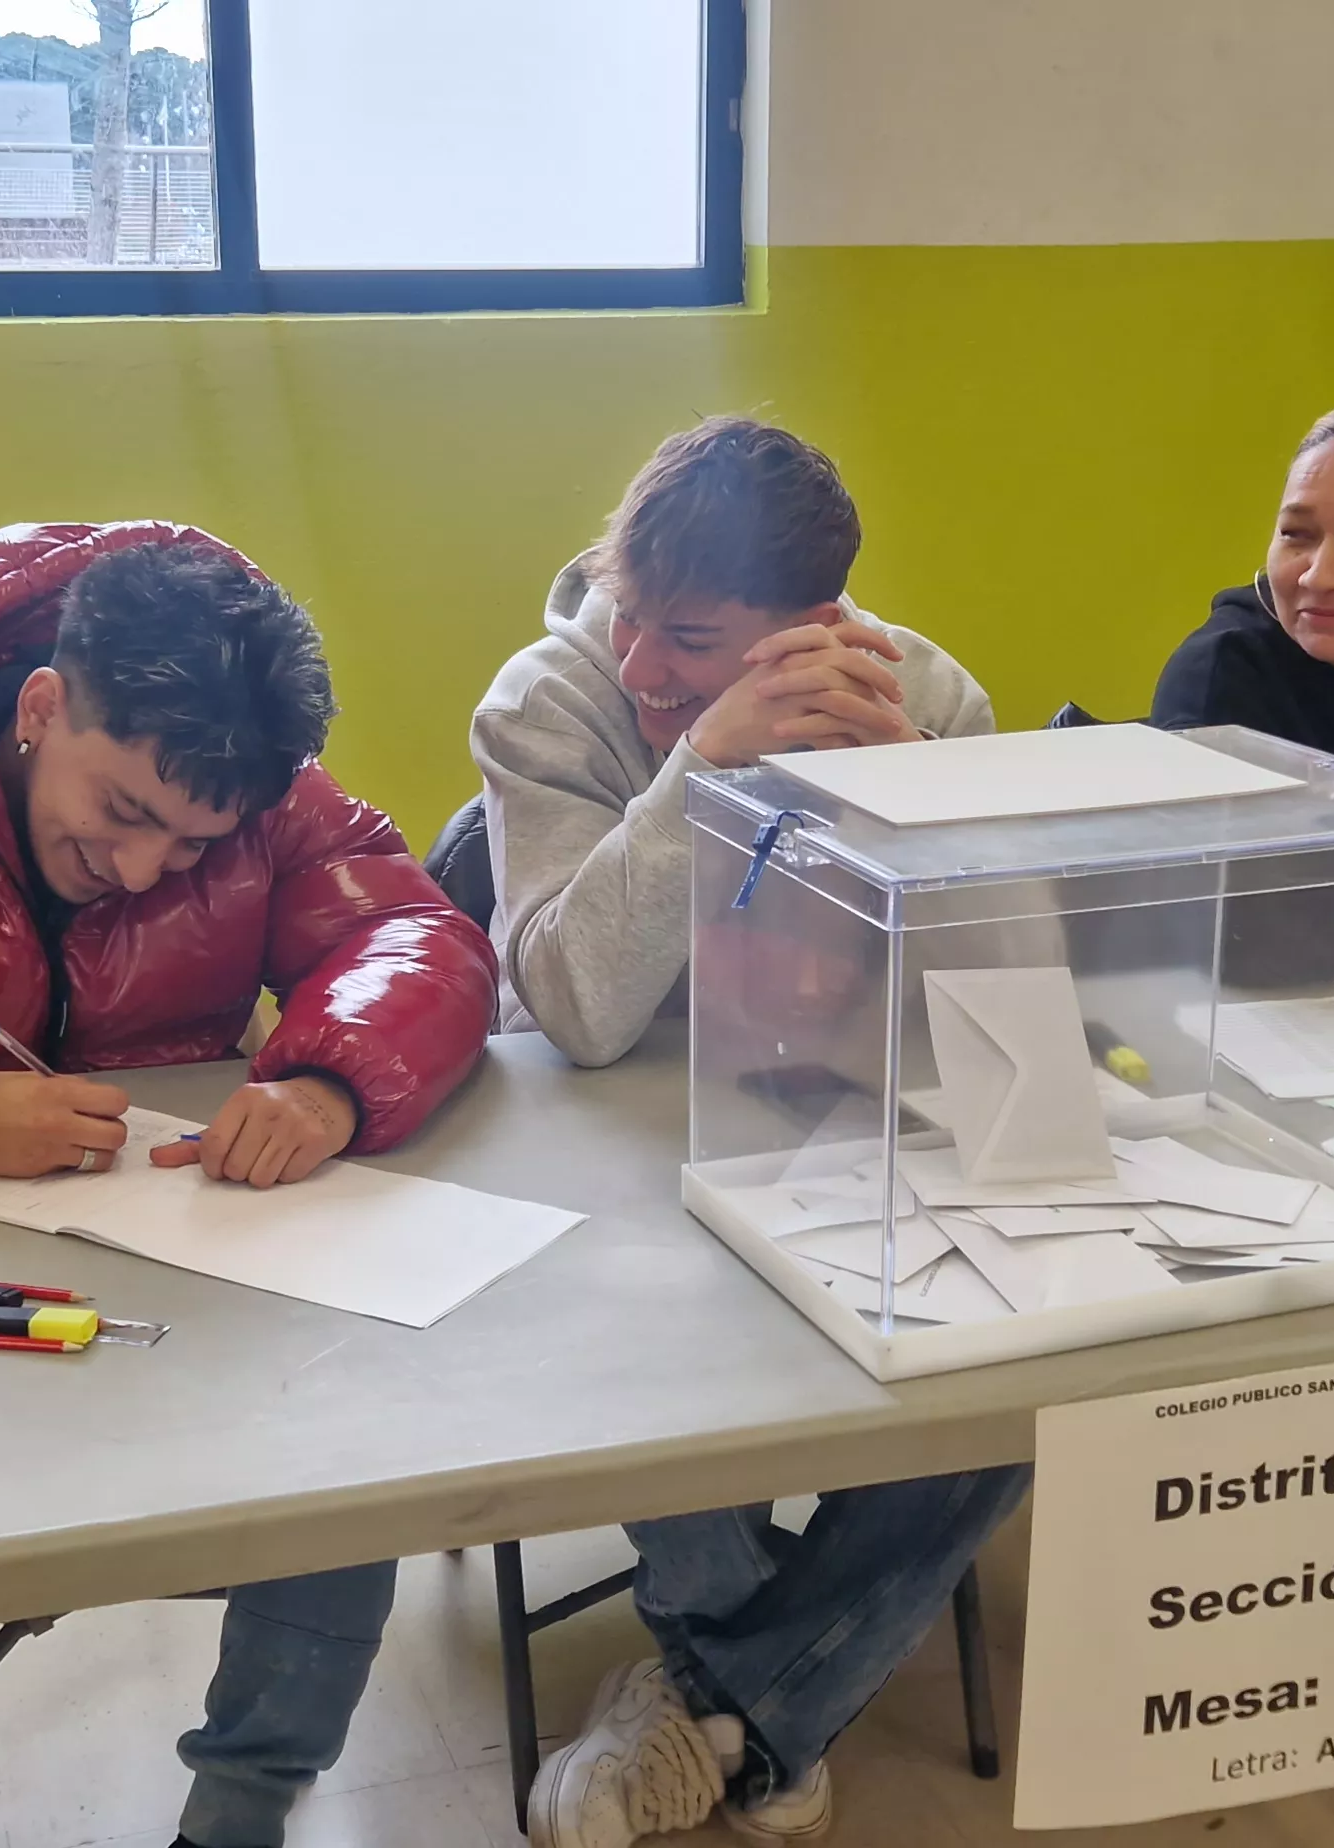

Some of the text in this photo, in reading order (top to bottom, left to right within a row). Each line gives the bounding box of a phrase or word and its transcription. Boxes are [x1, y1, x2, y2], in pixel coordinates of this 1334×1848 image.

[1155, 1397, 1227, 1418] COLEGIO
[1232, 1383, 1302, 1406] PUBLICO
[1143, 1677, 1319, 1736] Mesa:
[1211, 1749, 1298, 1783] Letra:
